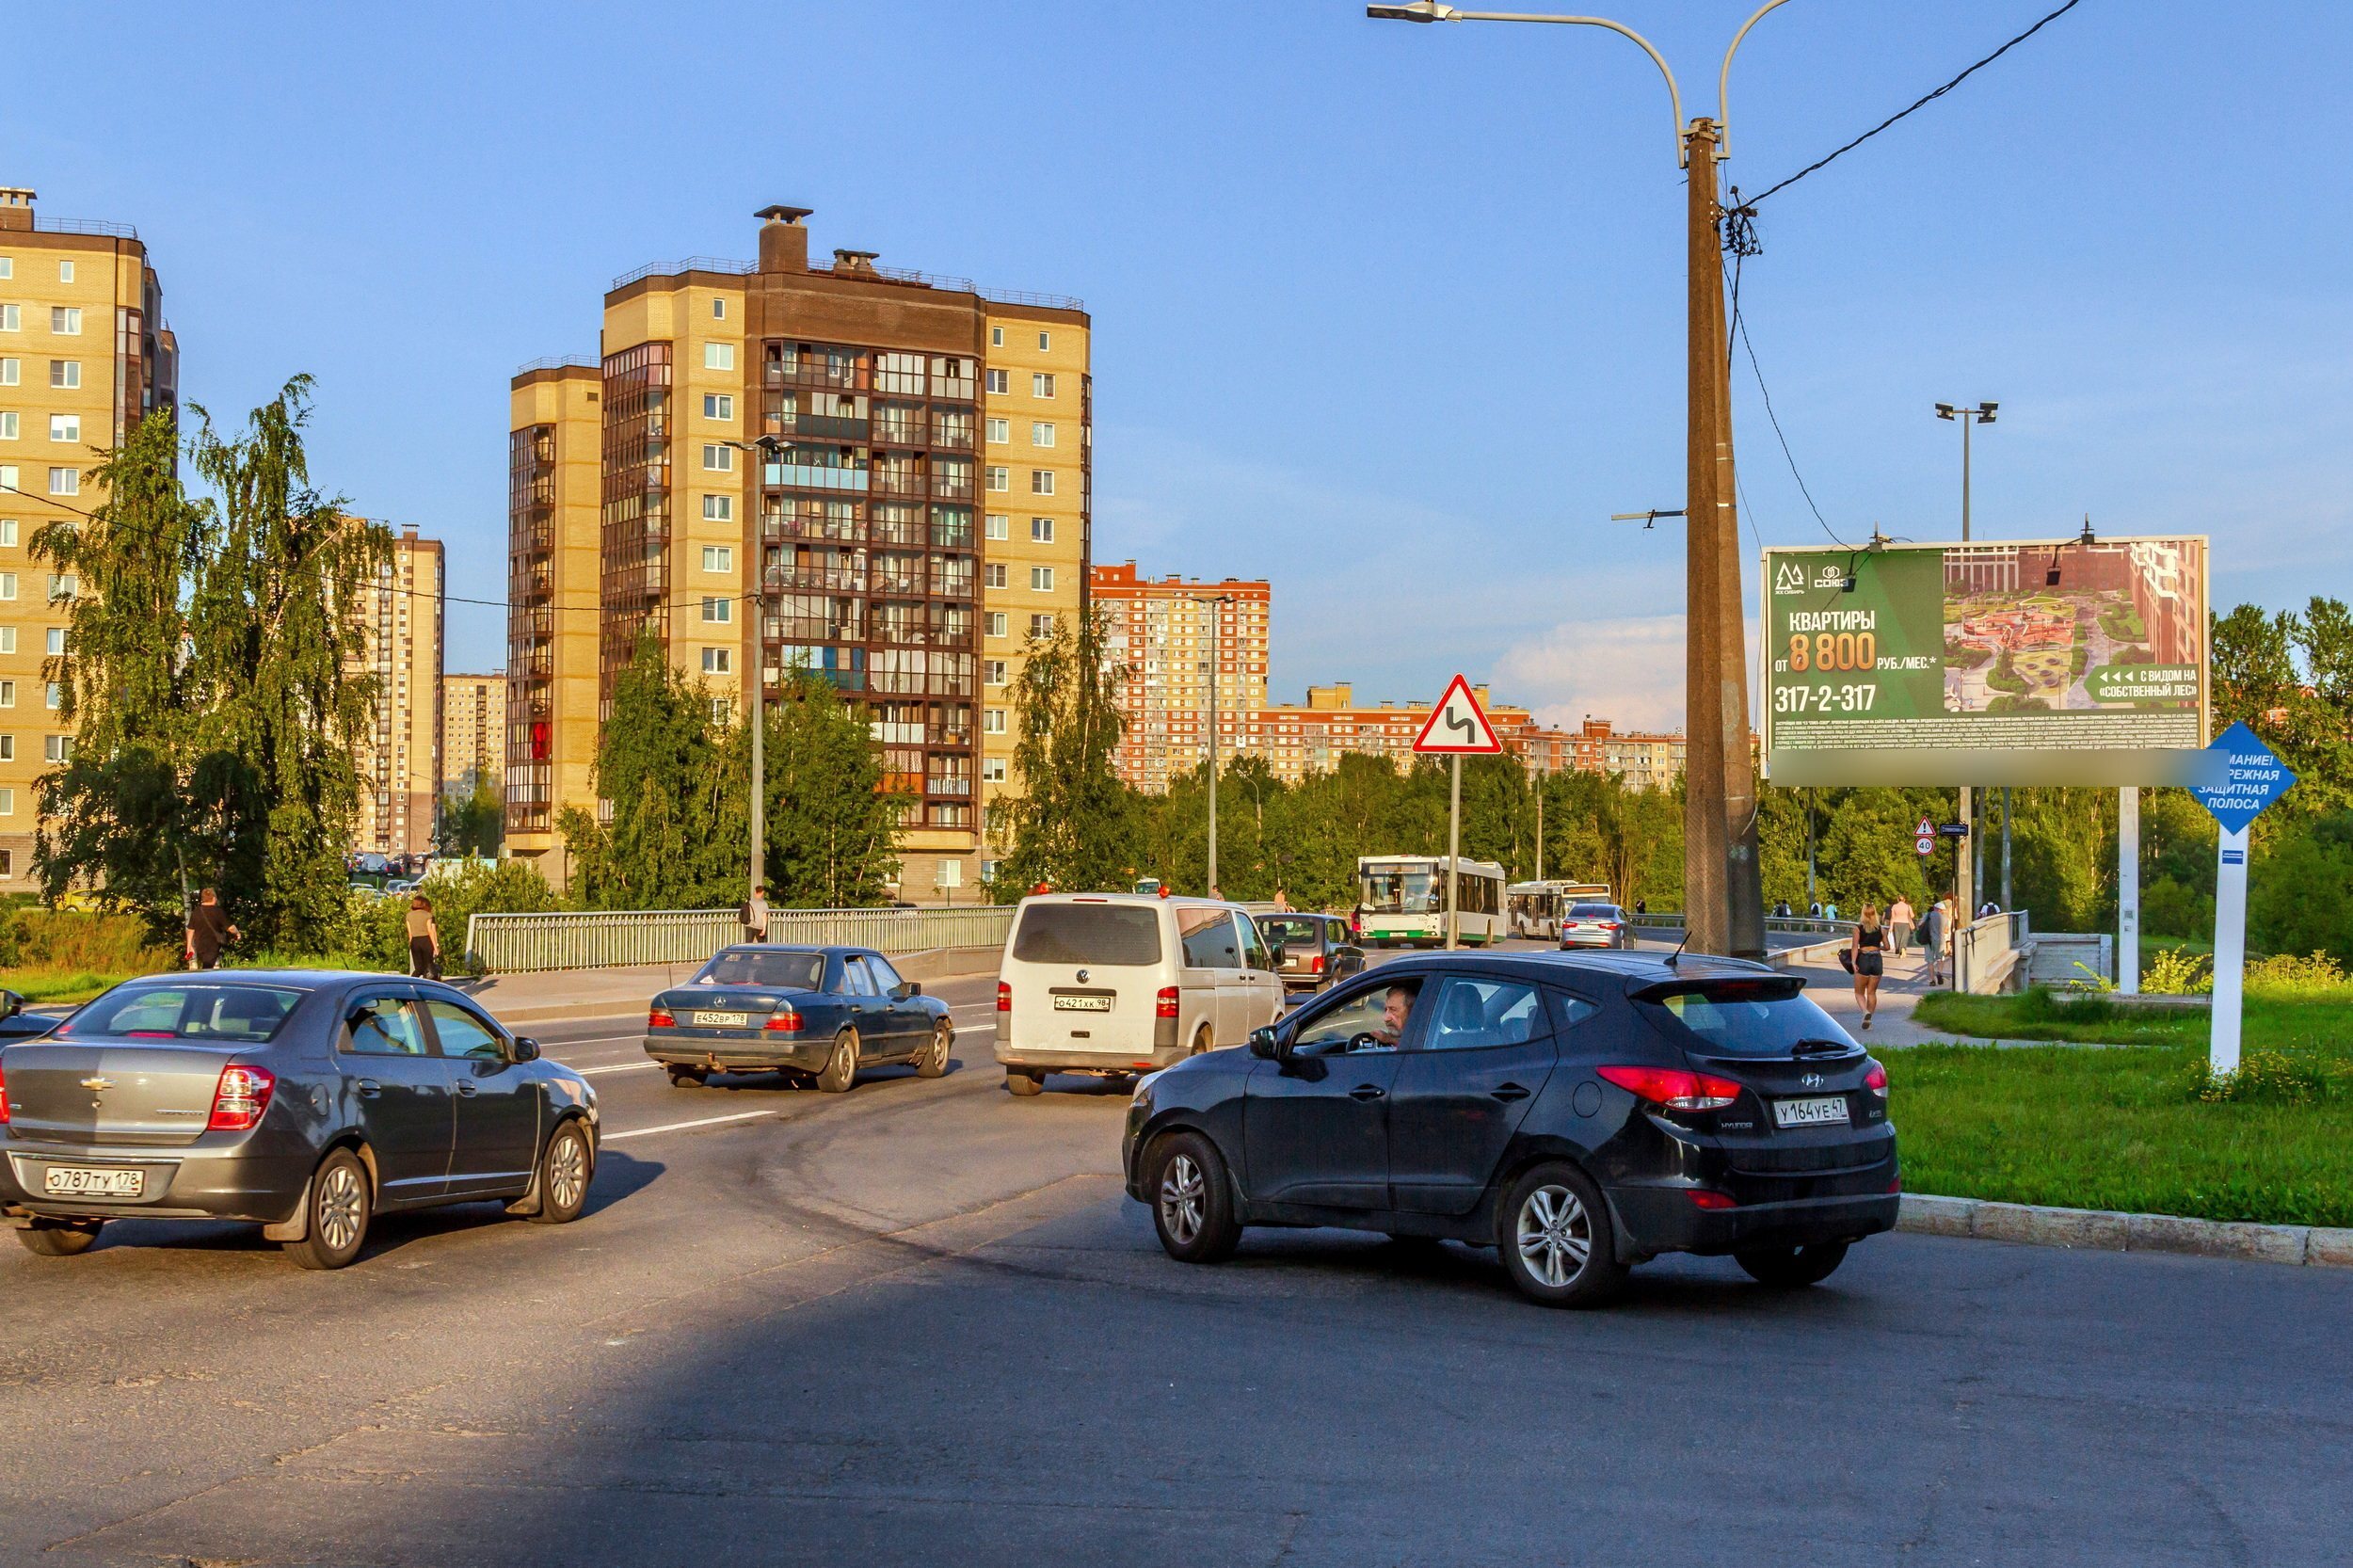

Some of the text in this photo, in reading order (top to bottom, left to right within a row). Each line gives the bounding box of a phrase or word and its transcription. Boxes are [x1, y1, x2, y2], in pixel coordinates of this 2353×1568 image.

[1815, 579, 1849, 587] СОЮЗ
[1789, 611, 1876, 632] КВАРТИРЫ
[1775, 660, 1787, 672] ОТ
[1790, 633, 1810, 671] 8
[1816, 632, 1876, 670] 800
[2140, 669, 2197, 682] С ВИДОМ НА
[2099, 683, 2197, 697] «СОБСТВЕННЫЙ ЛЕС»
[1775, 684, 1876, 712] 317-2-317
[2207, 797, 2260, 809] ПОЛОСА
[1832, 1099, 1842, 1113] 47
[116, 1172, 137, 1185] 178
